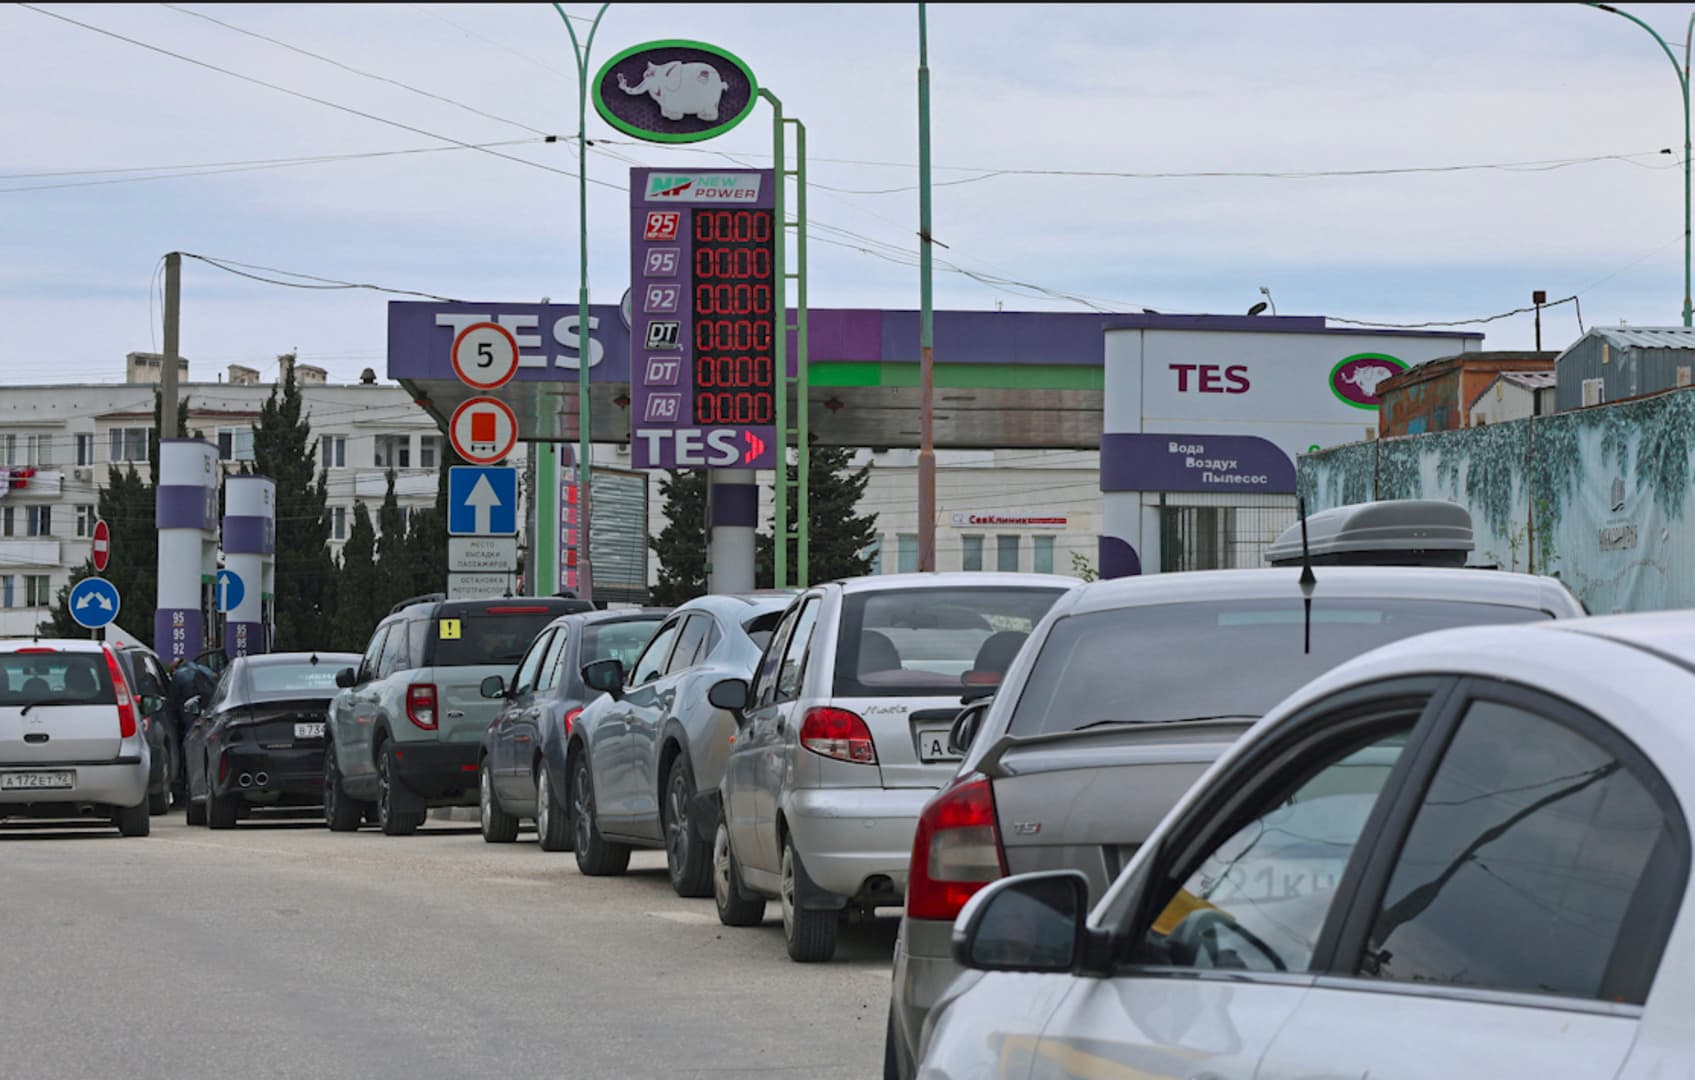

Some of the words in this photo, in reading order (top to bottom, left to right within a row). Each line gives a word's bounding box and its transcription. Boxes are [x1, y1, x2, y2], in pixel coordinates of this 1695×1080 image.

[695, 188, 756, 198] POWER
[698, 177, 736, 187] NEW
[650, 215, 675, 233] 95
[697, 212, 769, 242] 00.00
[650, 253, 675, 272] 95
[697, 248, 769, 278] 00.00
[649, 290, 674, 308] 92
[697, 284, 769, 314] 00.00
[435, 313, 604, 369] TES
[650, 323, 677, 341] DT
[697, 321, 770, 350] 00.00
[477, 343, 494, 367] 5
[649, 362, 677, 381] DT
[698, 357, 770, 386] 00.00
[1168, 363, 1250, 394] TES
[651, 399, 676, 417] ГАЗ
[698, 393, 770, 422] 00.00
[636, 429, 740, 466] TES
[1168, 441, 1204, 455] Вода
[1186, 457, 1237, 470] Воздух
[1202, 471, 1268, 484] Пылесос
[172, 611, 185, 623] 95
[173, 628, 185, 641] 95
[236, 638, 247, 648] 95
[173, 642, 185, 655] 92
